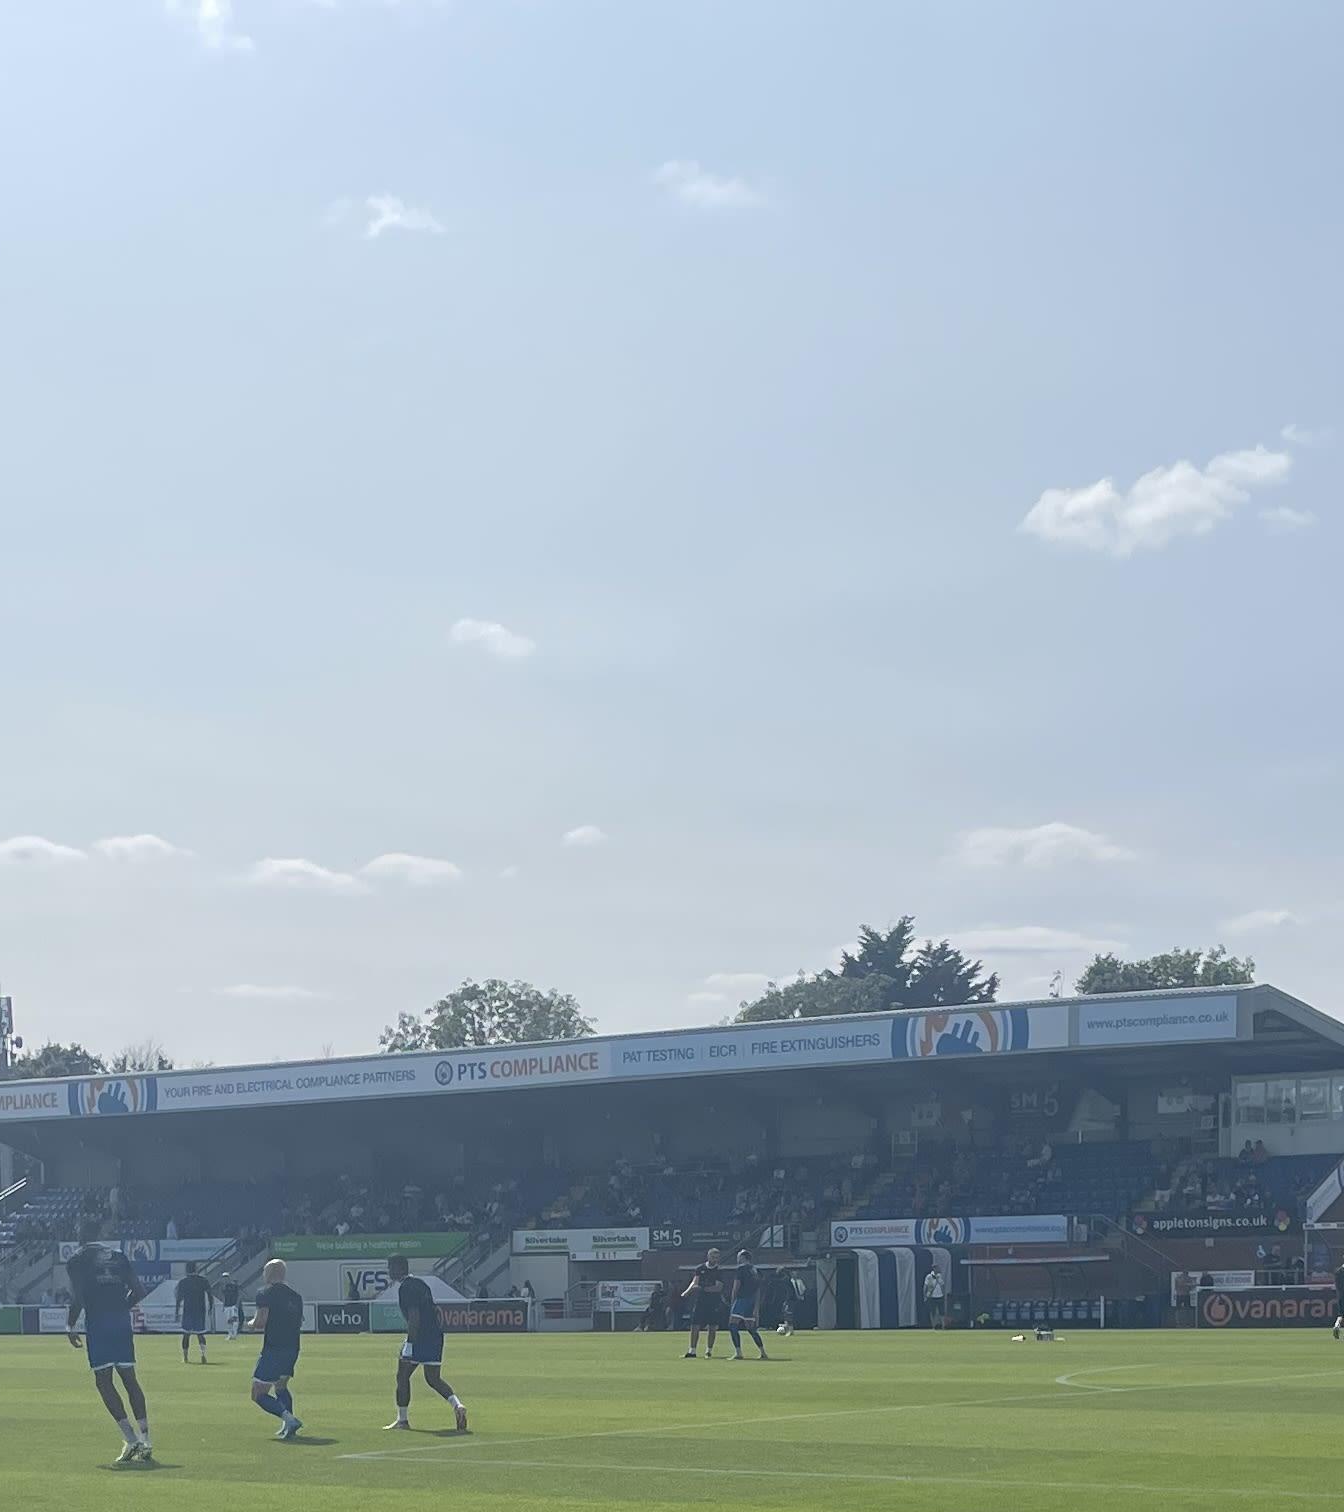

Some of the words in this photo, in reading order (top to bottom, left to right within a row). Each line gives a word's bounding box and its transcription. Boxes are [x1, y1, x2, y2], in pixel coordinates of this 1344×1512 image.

[1087, 1011, 1230, 1030] www.ptscompliance.co.uk
[709, 1044, 737, 1057] EICR
[751, 1040, 777, 1055] FIRE
[780, 1033, 880, 1053] EXTINGUISHERS
[622, 1051, 642, 1063] PAT
[645, 1047, 694, 1061] TESTING
[457, 1061, 487, 1081] PTS
[489, 1052, 599, 1079] COMPLIANCE
[163, 1086, 190, 1099] YOUR
[191, 1084, 213, 1097] FIRE
[214, 1083, 235, 1096] AND
[236, 1078, 294, 1094] ELECTRICAL
[295, 1073, 361, 1090] COMPLIANCE
[362, 1069, 417, 1086] PARTNERS
[1153, 1214, 1268, 1231] appletonsigns.co.uk
[324, 1309, 362, 1325] veho
[444, 1309, 524, 1326] vanarama
